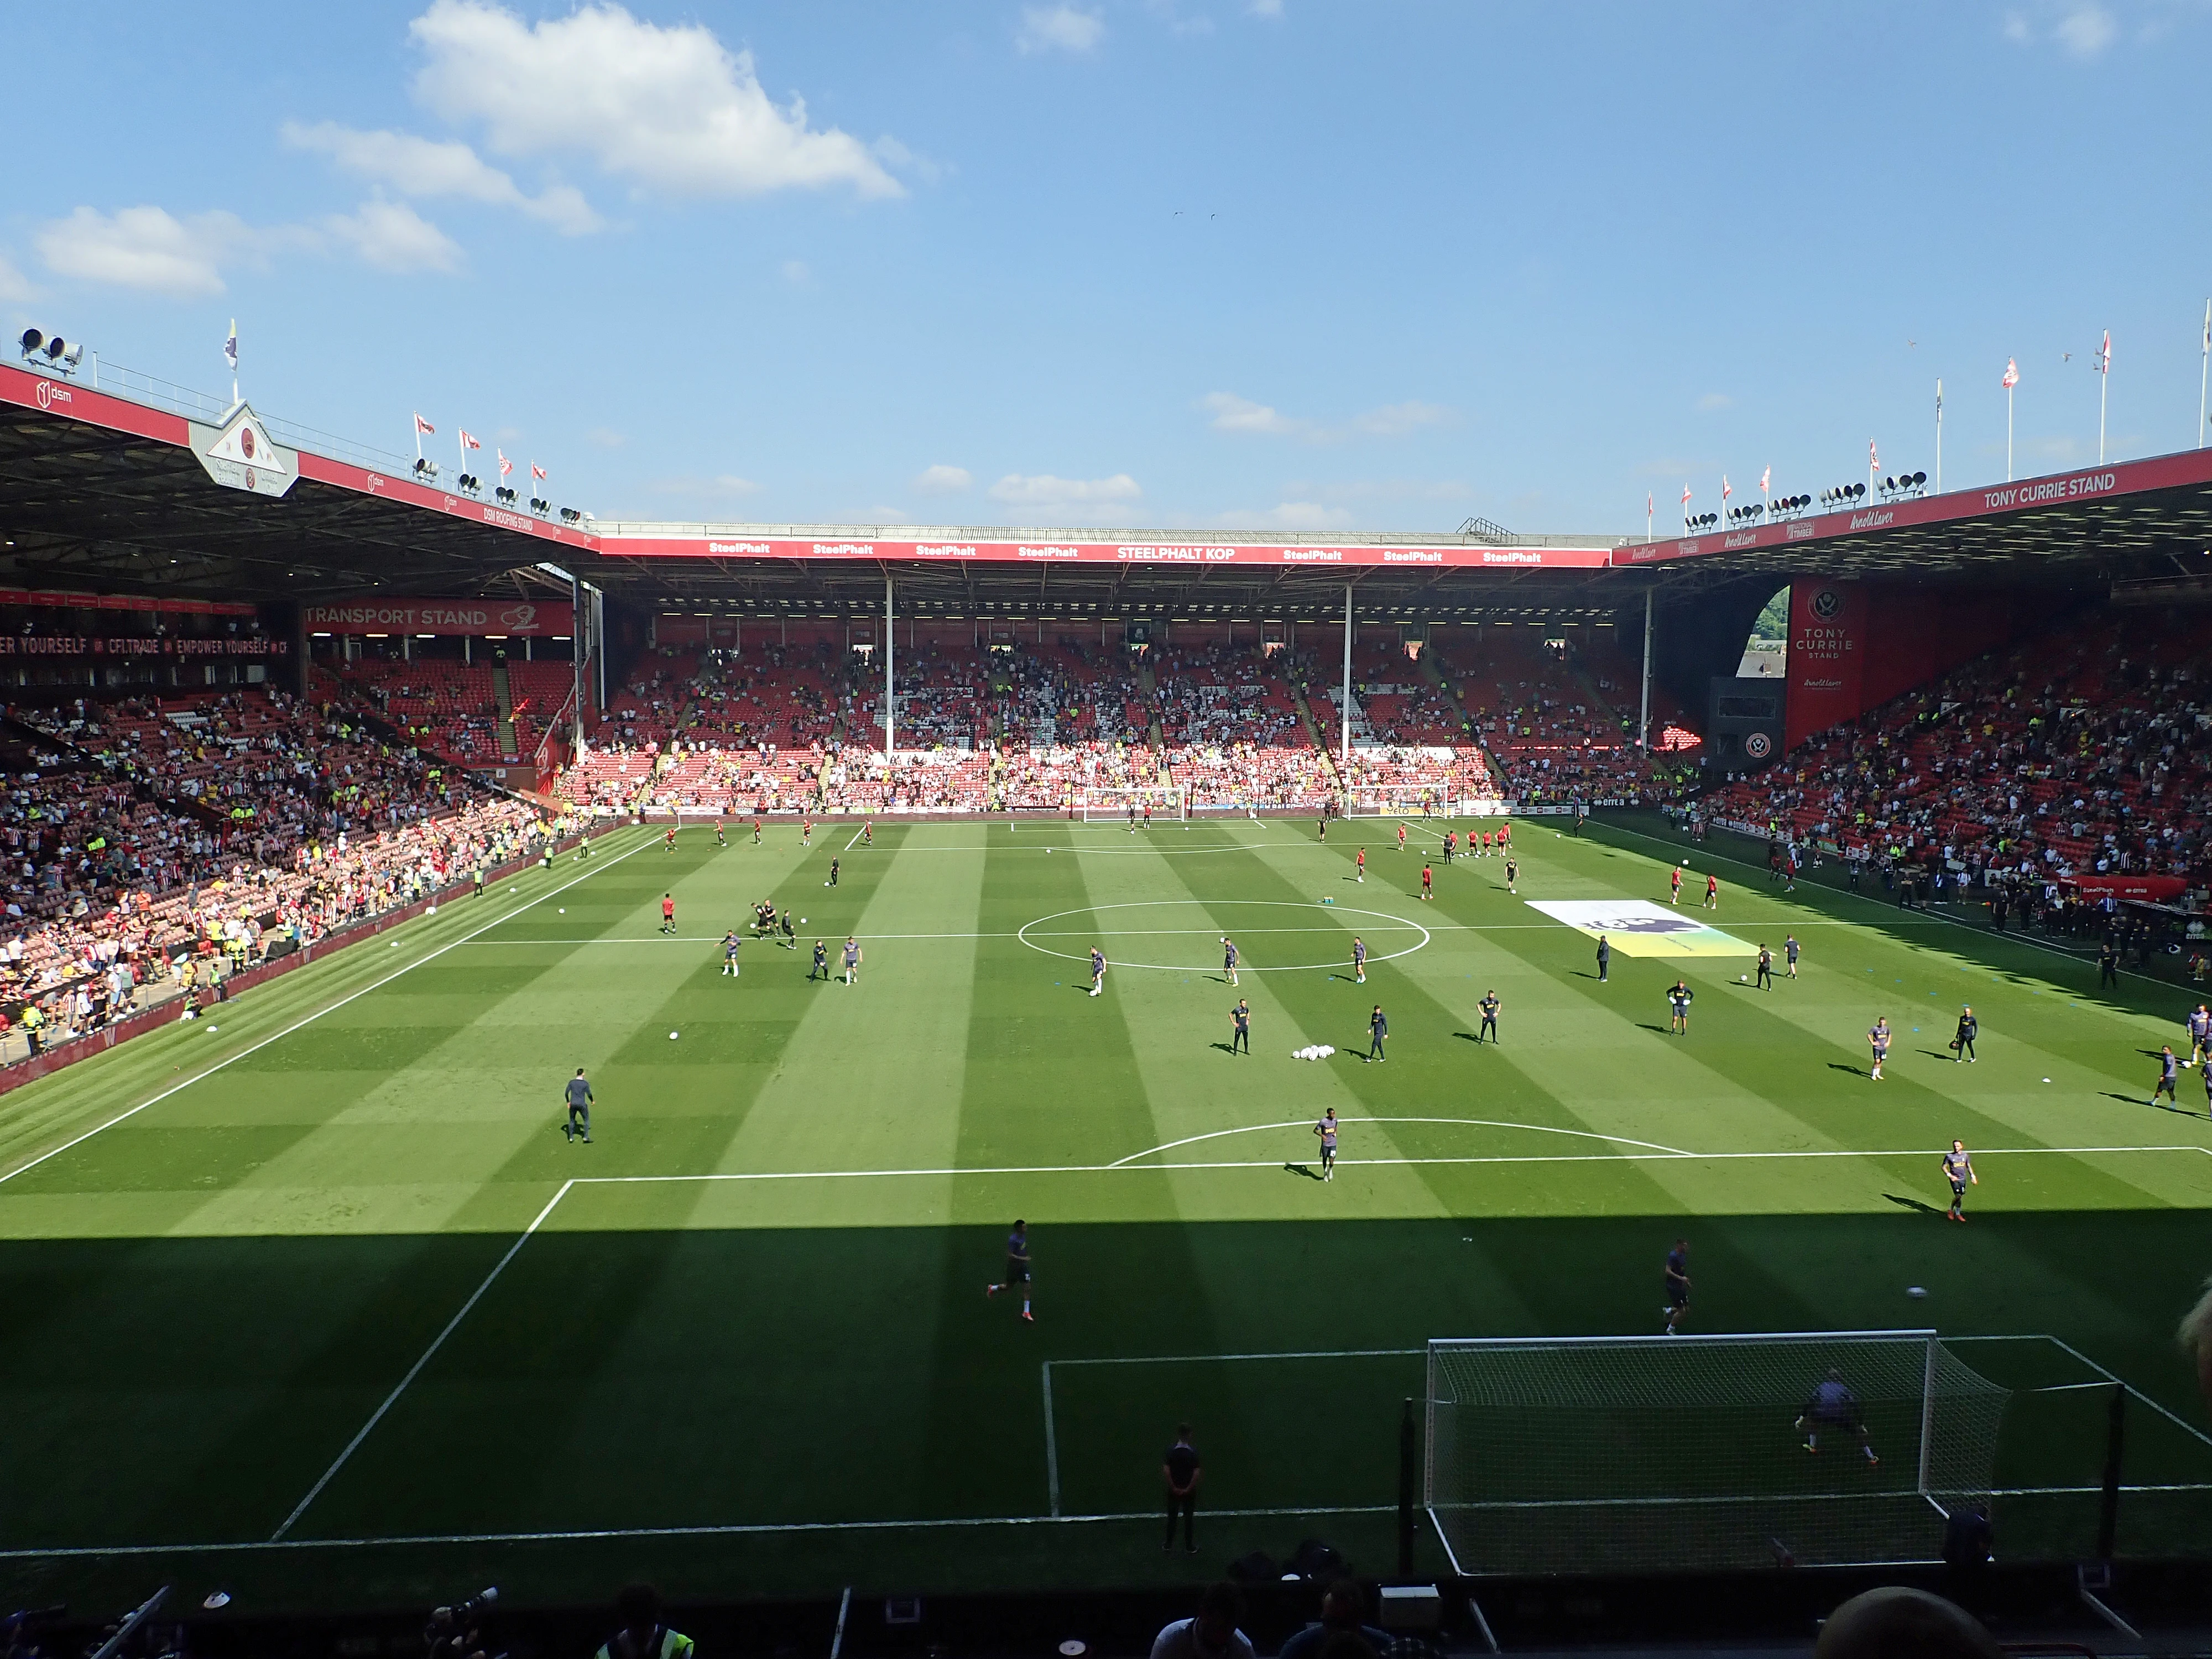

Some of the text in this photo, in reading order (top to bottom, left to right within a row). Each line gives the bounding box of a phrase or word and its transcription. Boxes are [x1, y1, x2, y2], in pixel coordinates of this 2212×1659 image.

[51, 387, 71, 403] dsm
[374, 477, 384, 487] dsm
[1985, 473, 2115, 508] TONY CURRIE STAND
[483, 508, 533, 531] DSM ROOFING STAND
[1793, 528, 1813, 539] TIMBER
[709, 542, 770, 554] SteelPhalt
[813, 544, 873, 555] SteelPhalt
[916, 545, 975, 556] SteelPhalt
[1018, 546, 1078, 557] SteelPhalt
[1118, 547, 1235, 560] STEELPHALT KOP
[1284, 549, 1342, 560] SteelPhalt
[1384, 551, 1442, 561] SteelPhalt
[1483, 552, 1541, 563] SteelPhalt
[307, 608, 487, 625] TRANSPORT STAND
[1804, 629, 1846, 638] TONY
[20, 637, 87, 654] YOURSELF
[177, 639, 222, 654] EMPOWER
[226, 640, 268, 654] YOURSELF
[1796, 640, 1853, 650] CURRIE
